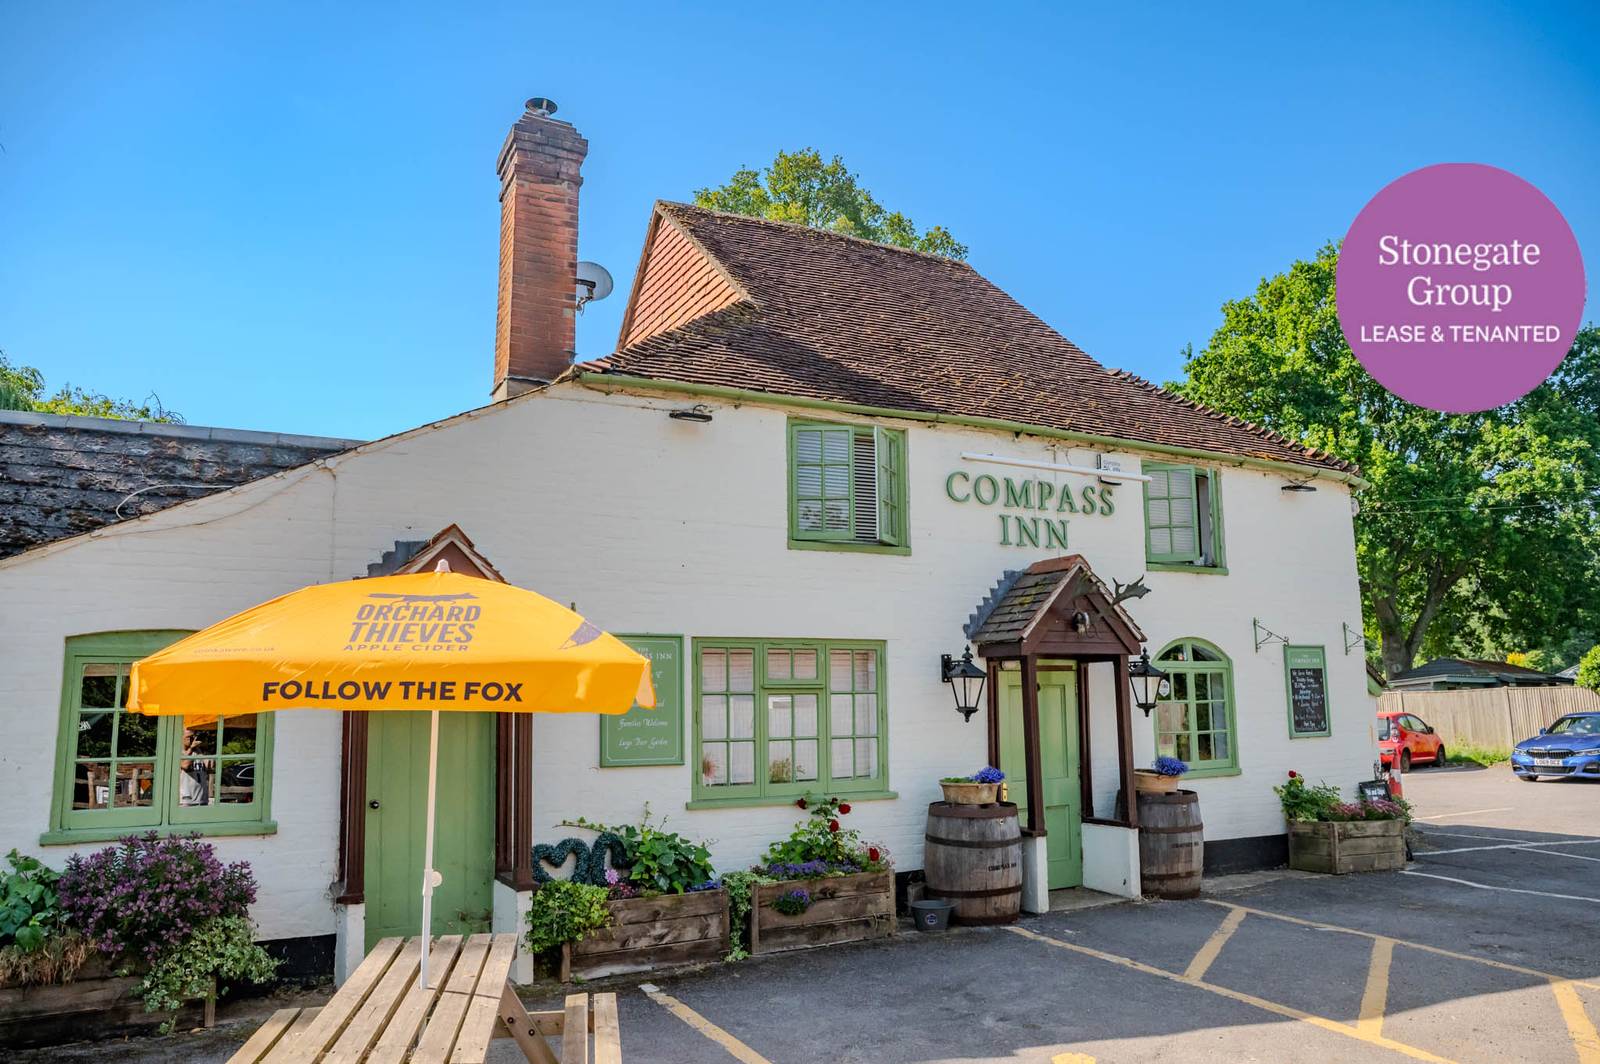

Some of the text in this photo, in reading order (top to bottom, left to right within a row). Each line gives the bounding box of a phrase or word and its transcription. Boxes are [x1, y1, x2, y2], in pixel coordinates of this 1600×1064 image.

[946, 471, 1116, 517] COMPASS
[998, 514, 1070, 549] INN
[356, 603, 481, 622] ORCHARD
[348, 622, 476, 643] THIEVES
[411, 644, 469, 652] CIDER
[262, 680, 524, 702] FOLLOW THE FOX
